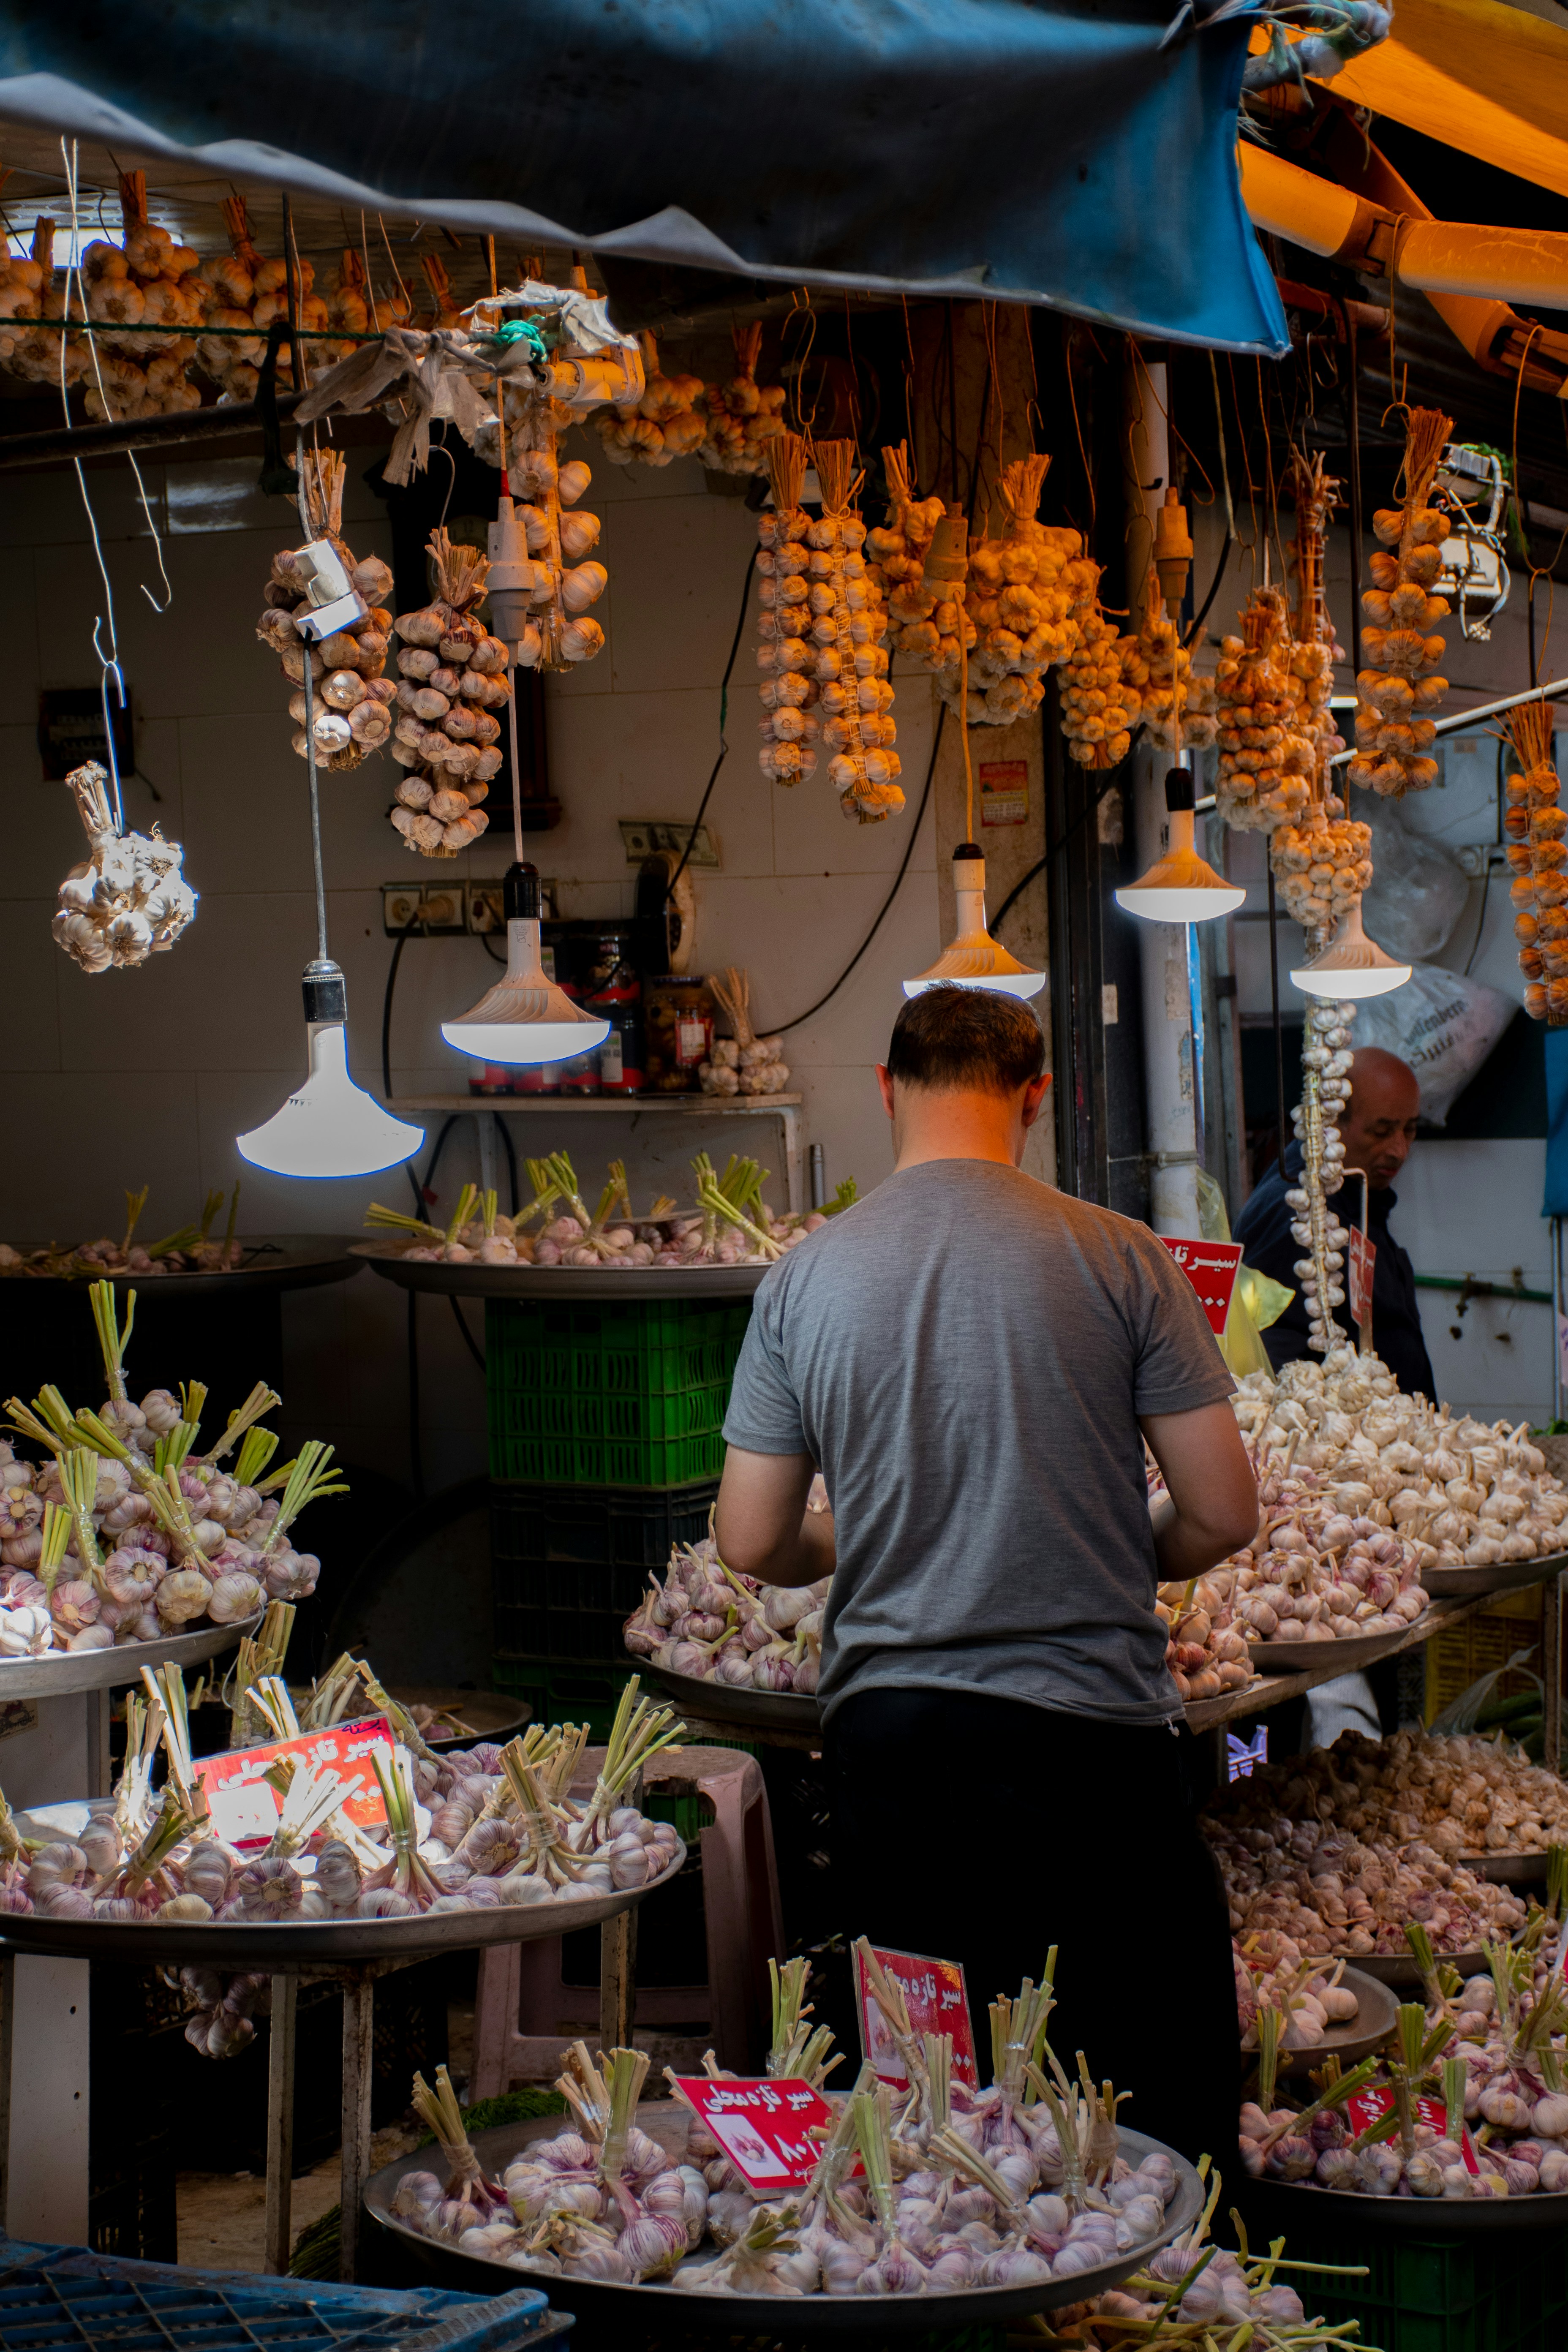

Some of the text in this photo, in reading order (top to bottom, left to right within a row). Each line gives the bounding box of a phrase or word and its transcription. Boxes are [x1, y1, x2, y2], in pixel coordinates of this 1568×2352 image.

[1187, 1256, 1237, 1273] سیر
[217, 1759, 273, 1791] حلی
[911, 1972, 936, 2006] تازه
[940, 1989, 961, 2010] سیر
[702, 2083, 815, 2113] سیر تازه محلی
